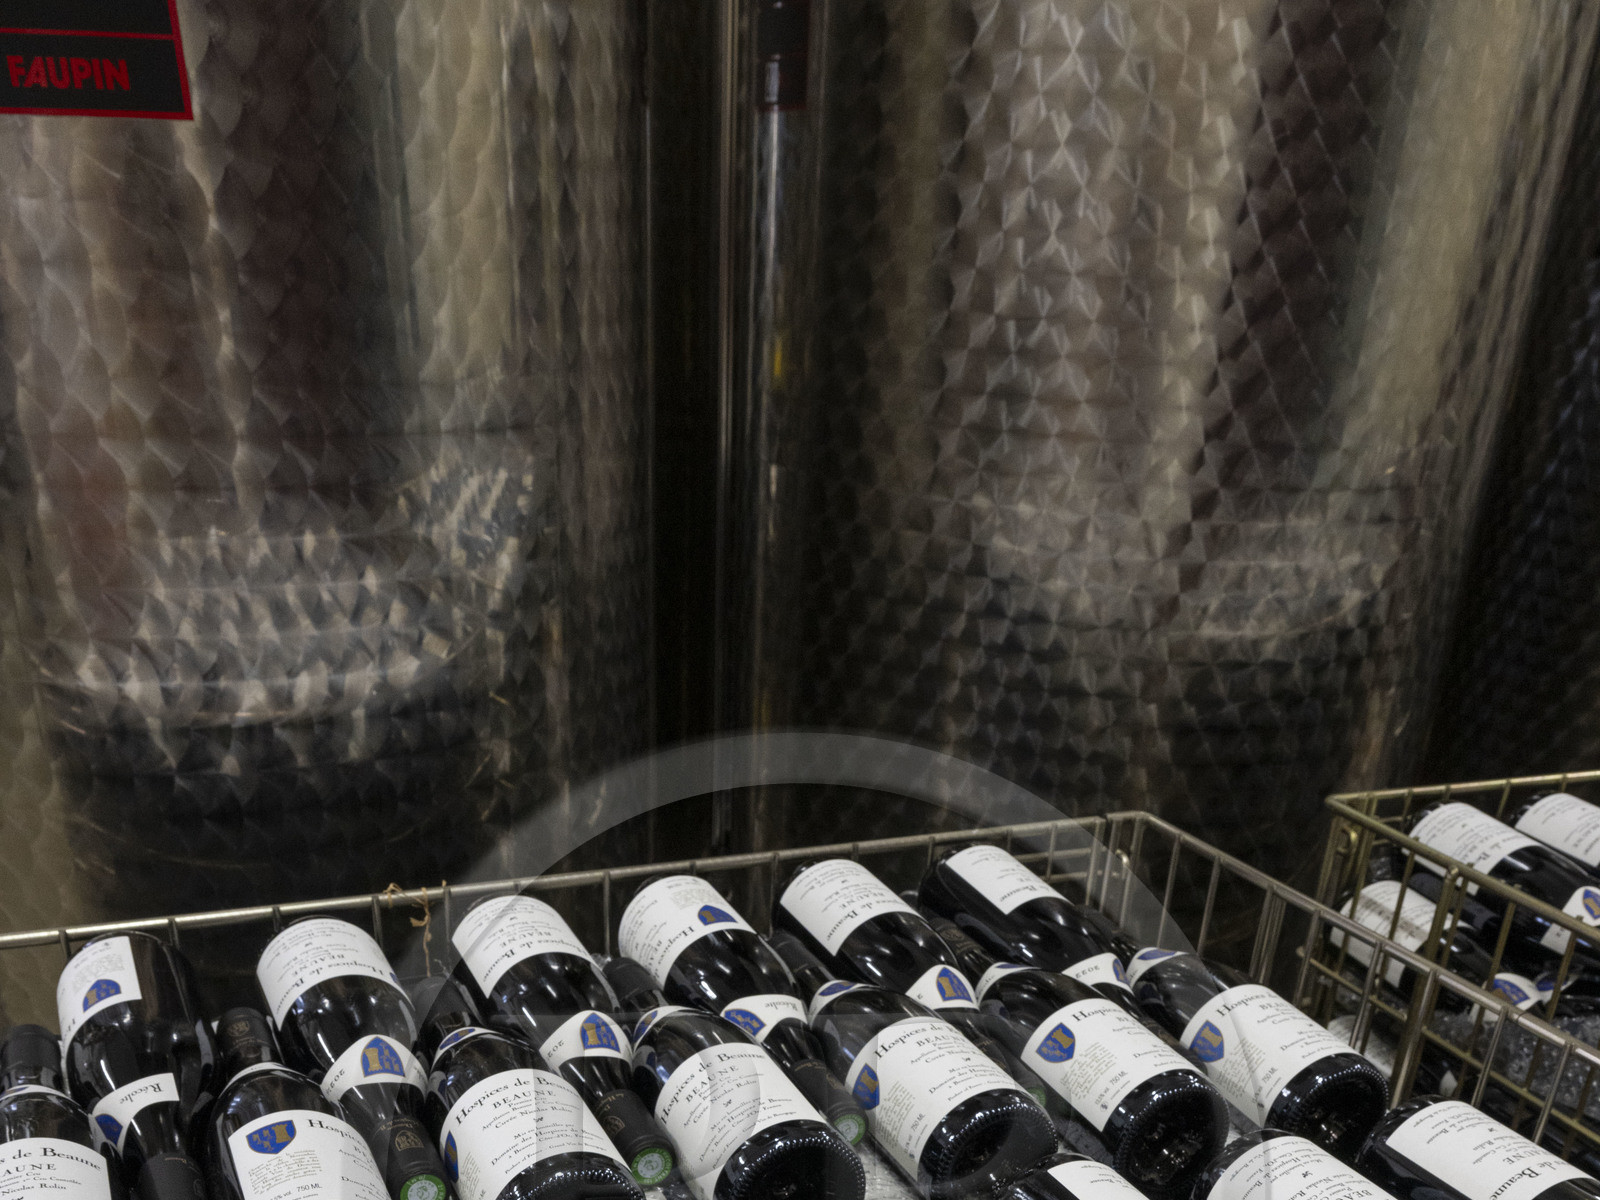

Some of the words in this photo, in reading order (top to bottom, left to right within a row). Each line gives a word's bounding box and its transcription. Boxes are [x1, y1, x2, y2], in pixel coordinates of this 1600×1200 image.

[7, 55, 130, 90] FAUPIN
[874, 1028, 927, 1059] Hospices
[120, 1081, 162, 1104] Récolte
[456, 1085, 509, 1125] Hospices
[514, 1078, 530, 1087] de
[492, 1090, 556, 1109] BEAUNE
[12, 1149, 32, 1160] de
[42, 1147, 101, 1170] Beaune
